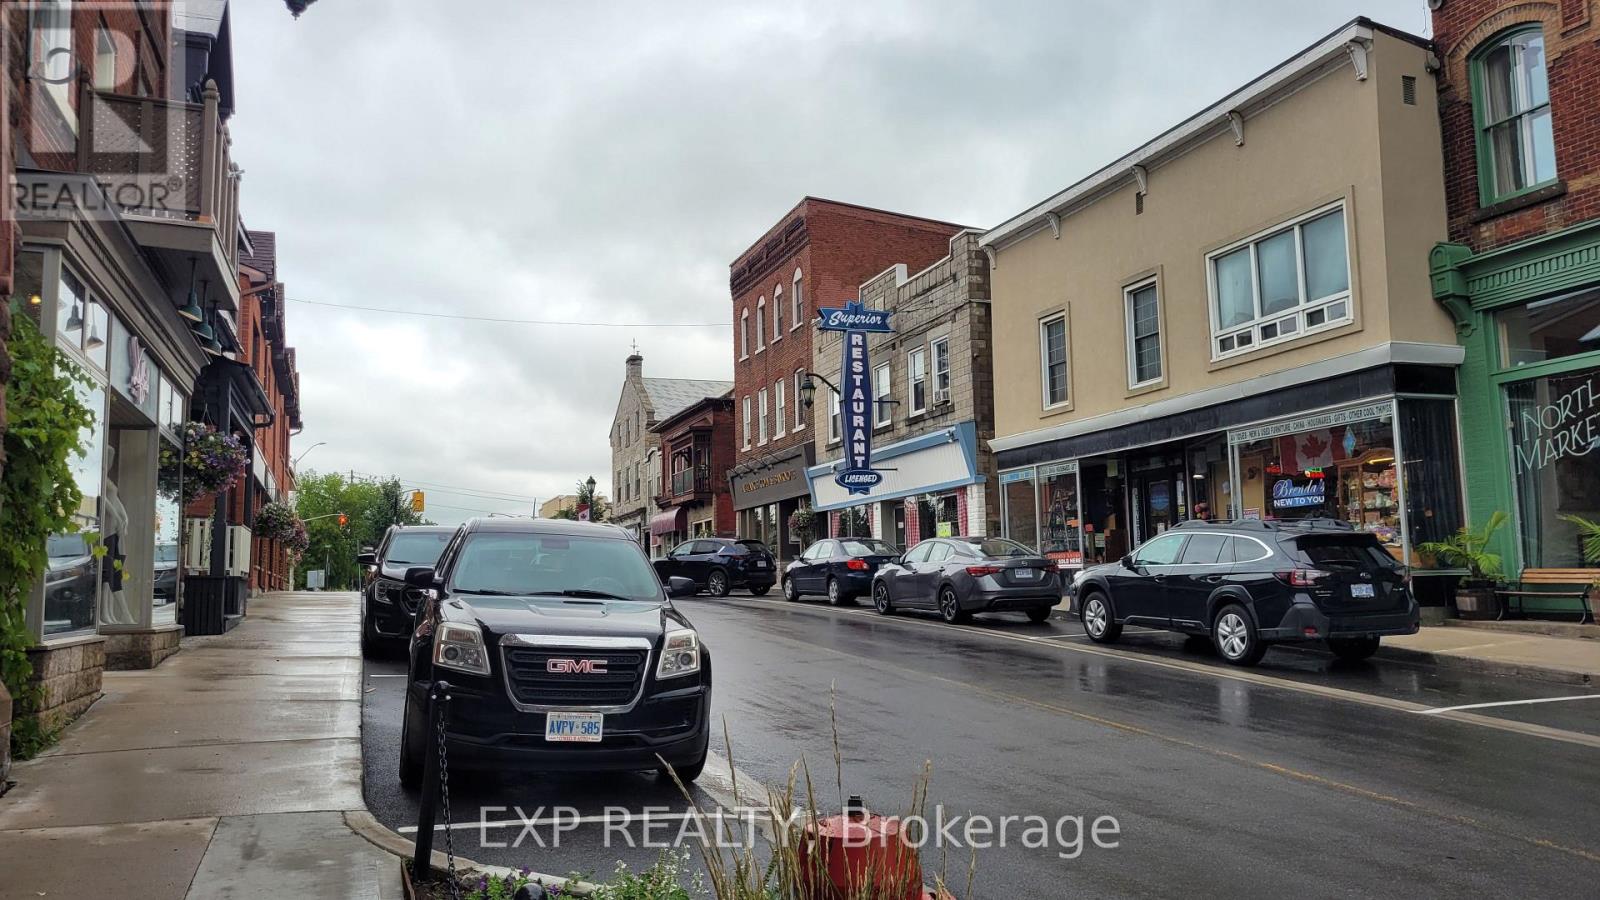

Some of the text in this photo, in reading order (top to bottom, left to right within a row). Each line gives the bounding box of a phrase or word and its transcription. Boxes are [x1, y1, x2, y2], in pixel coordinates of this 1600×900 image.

[828, 310, 882, 327] Superior
[851, 334, 866, 468] RESTAURANT
[1515, 412, 1600, 475] MARKE
[1273, 478, 1325, 498] Brenda's
[1274, 498, 1293, 507] NEW
[1307, 495, 1325, 503] YOU
[547, 658, 608, 674] GMC
